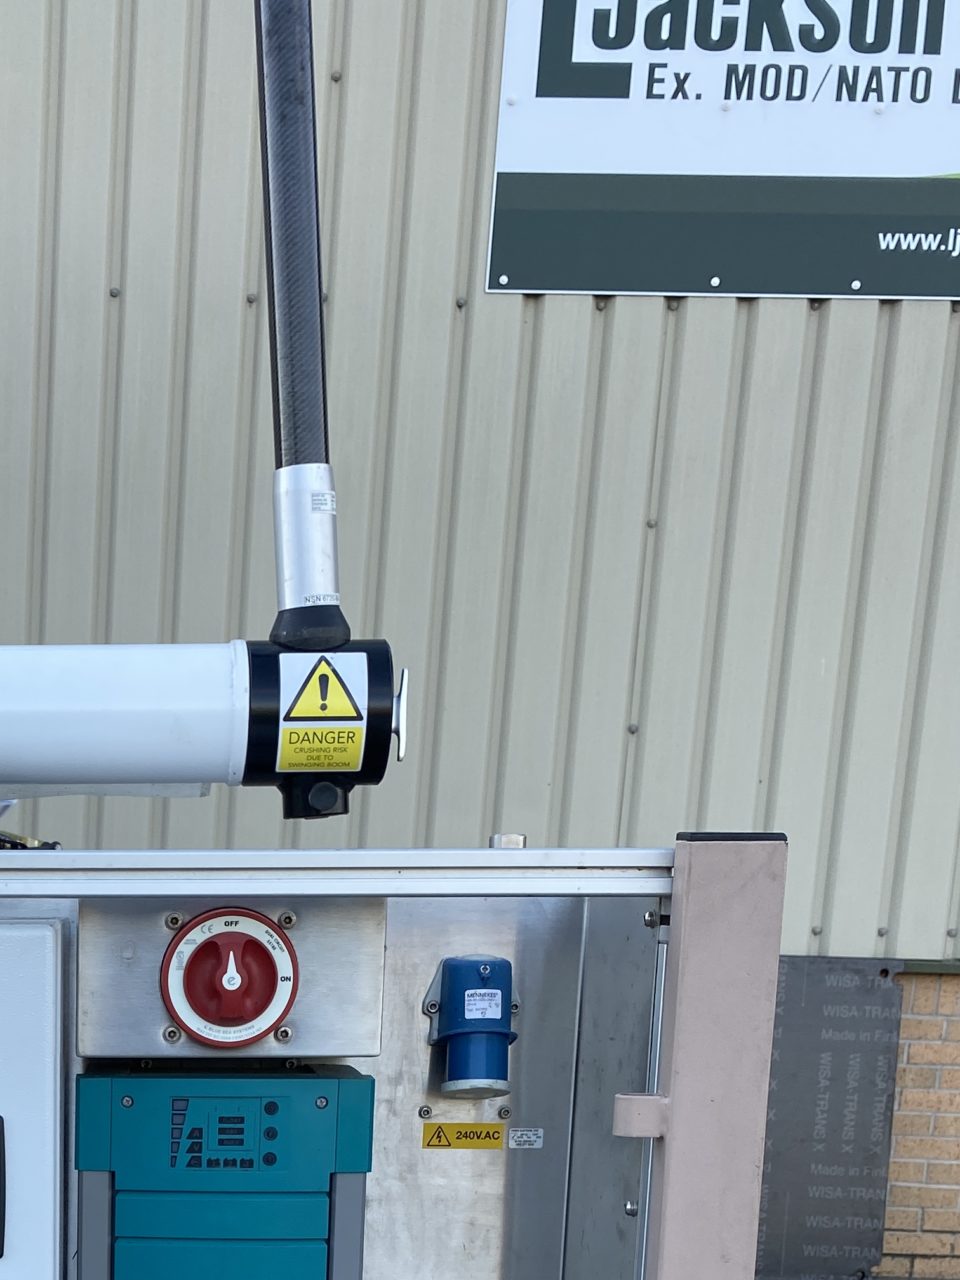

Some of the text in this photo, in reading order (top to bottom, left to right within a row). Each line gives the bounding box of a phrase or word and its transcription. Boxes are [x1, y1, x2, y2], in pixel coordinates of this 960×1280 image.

[645, 62, 702, 100] Ex.
[724, 63, 932, 104] MOD/NATO
[288, 730, 356, 745] DANGER
[821, 1028, 856, 1041] Made
[860, 1030, 870, 1042] in
[814, 1052, 832, 1139] WISA-TRANS
[841, 1052, 861, 1140] WISA-TRANS
[455, 1130, 501, 1140] 240V.AC
[810, 1162, 846, 1176] Made
[848, 1166, 860, 1176] in
